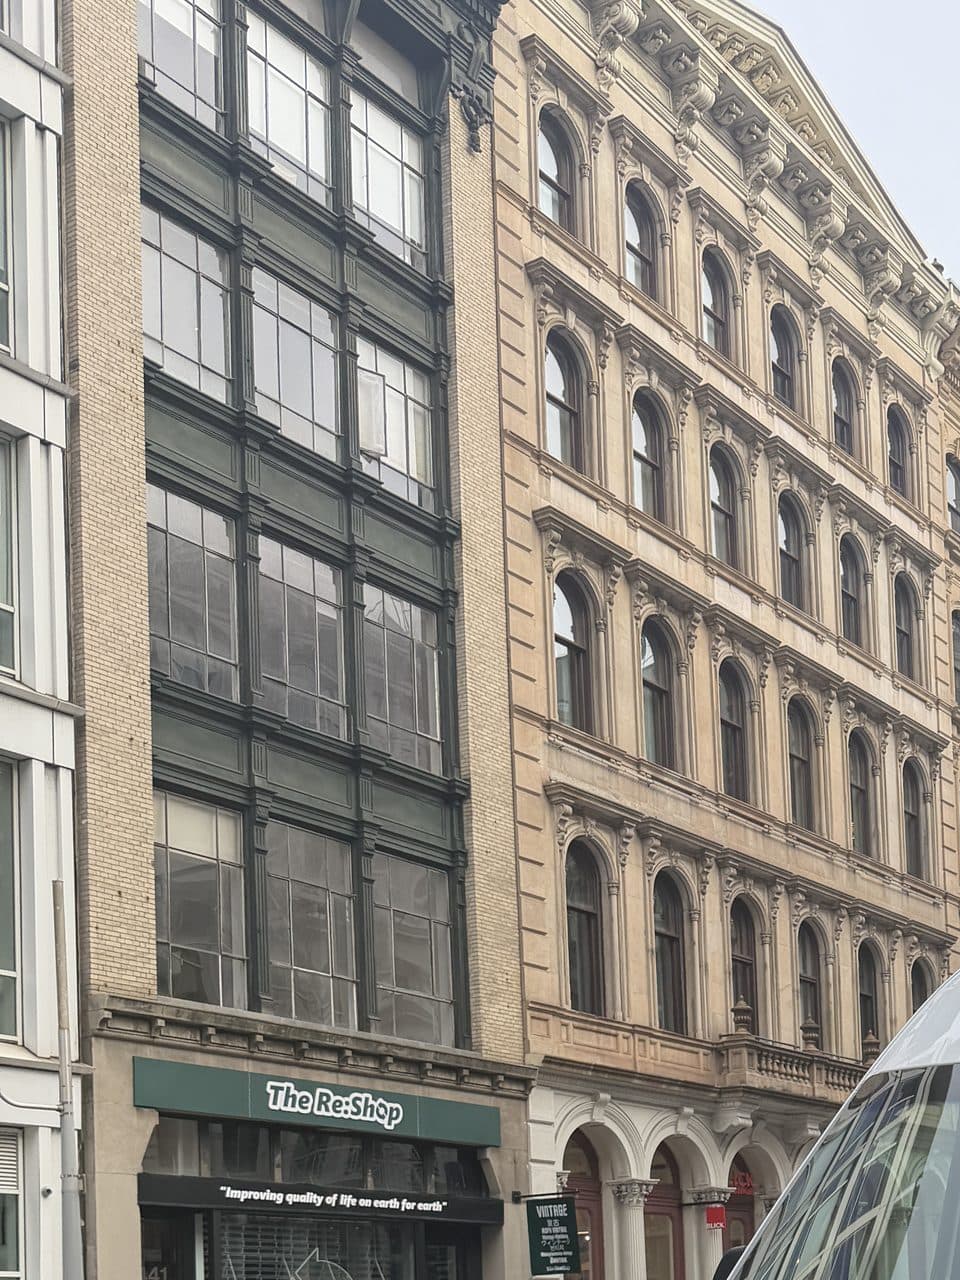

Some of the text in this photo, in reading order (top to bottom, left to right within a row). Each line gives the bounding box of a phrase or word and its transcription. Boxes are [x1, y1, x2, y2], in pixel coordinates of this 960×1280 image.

[266, 1081, 403, 1130] The Re:Shop
[285, 1192, 324, 1207] quality
[325, 1194, 339, 1207] of
[339, 1194, 357, 1209] life
[358, 1199, 372, 1207] on
[373, 1198, 400, 1209] earth
[401, 1198, 416, 1211] for
[417, 1201, 448, 1212] earth"
[536, 1204, 568, 1218] VINTAGE
